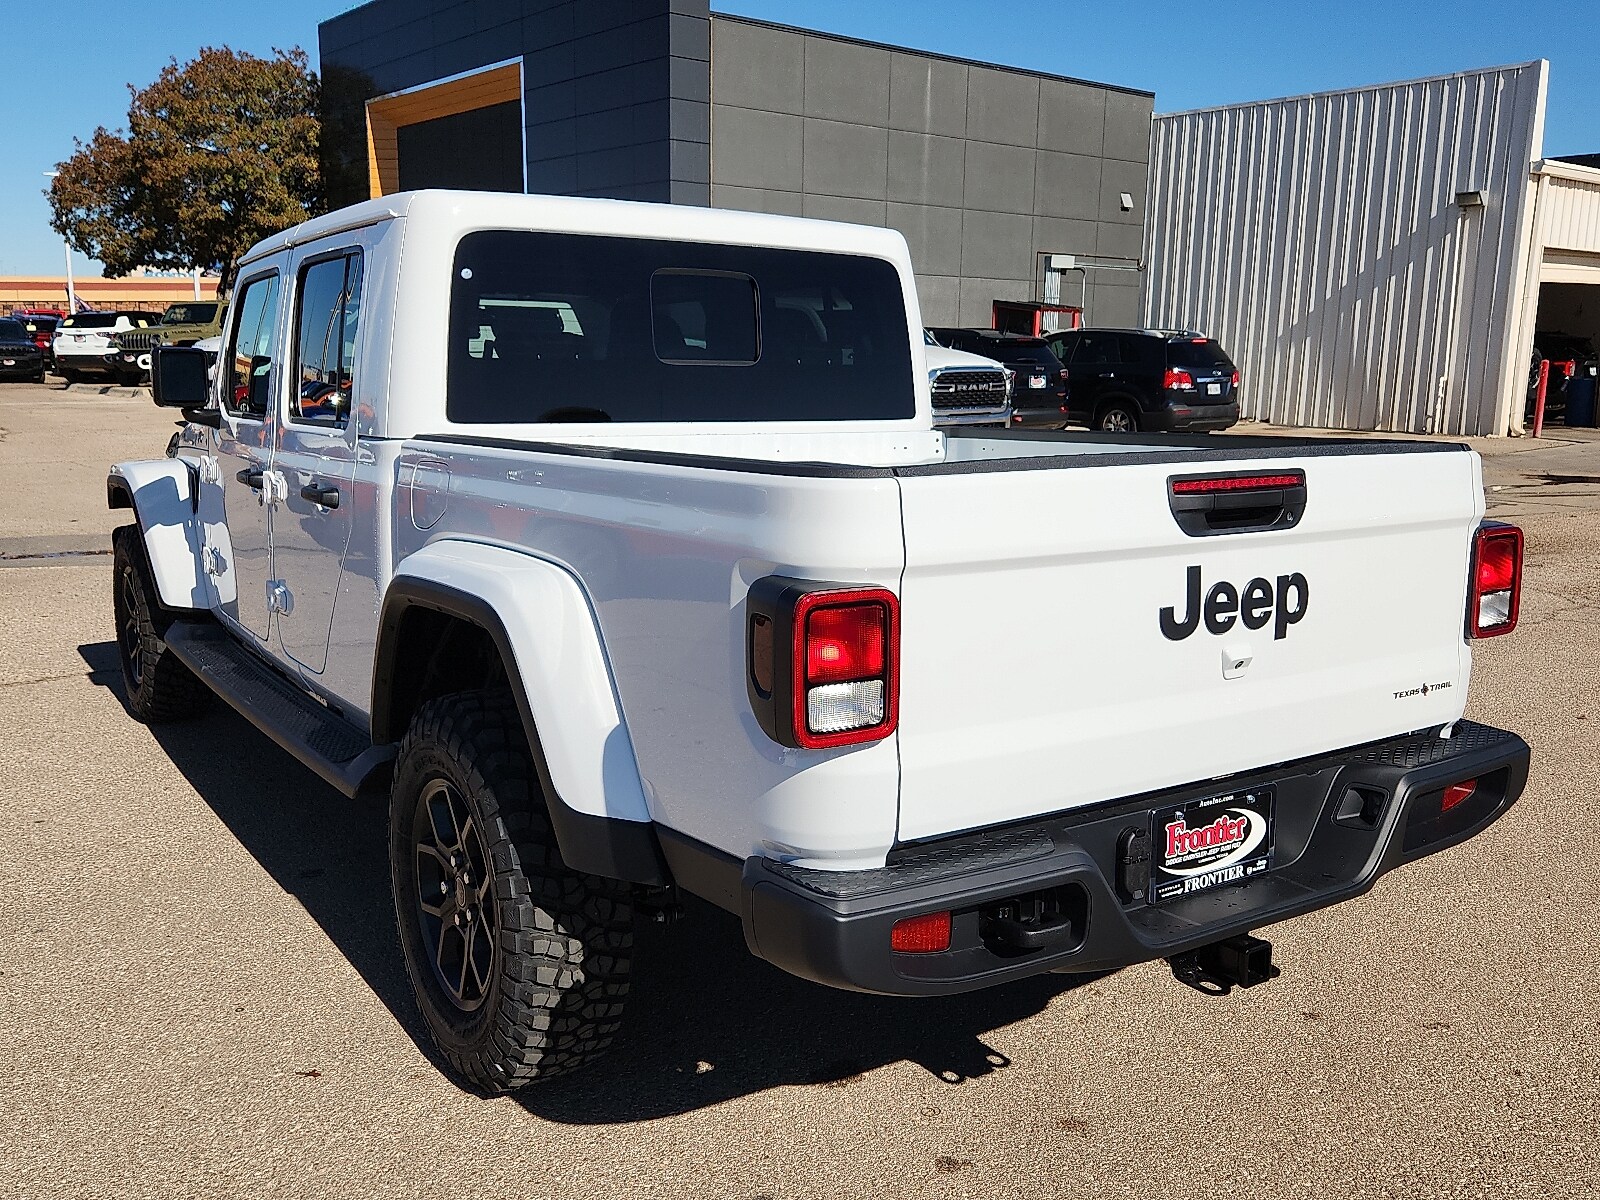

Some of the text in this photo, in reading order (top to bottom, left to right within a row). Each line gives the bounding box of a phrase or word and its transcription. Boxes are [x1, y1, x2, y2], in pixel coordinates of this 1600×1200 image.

[956, 383, 989, 391] RAM
[1159, 564, 1310, 641] Jeep
[1393, 681, 1452, 699] TEXAS TRAIL
[1166, 815, 1247, 857] Frontier
[1184, 865, 1245, 893] FRONTIER
